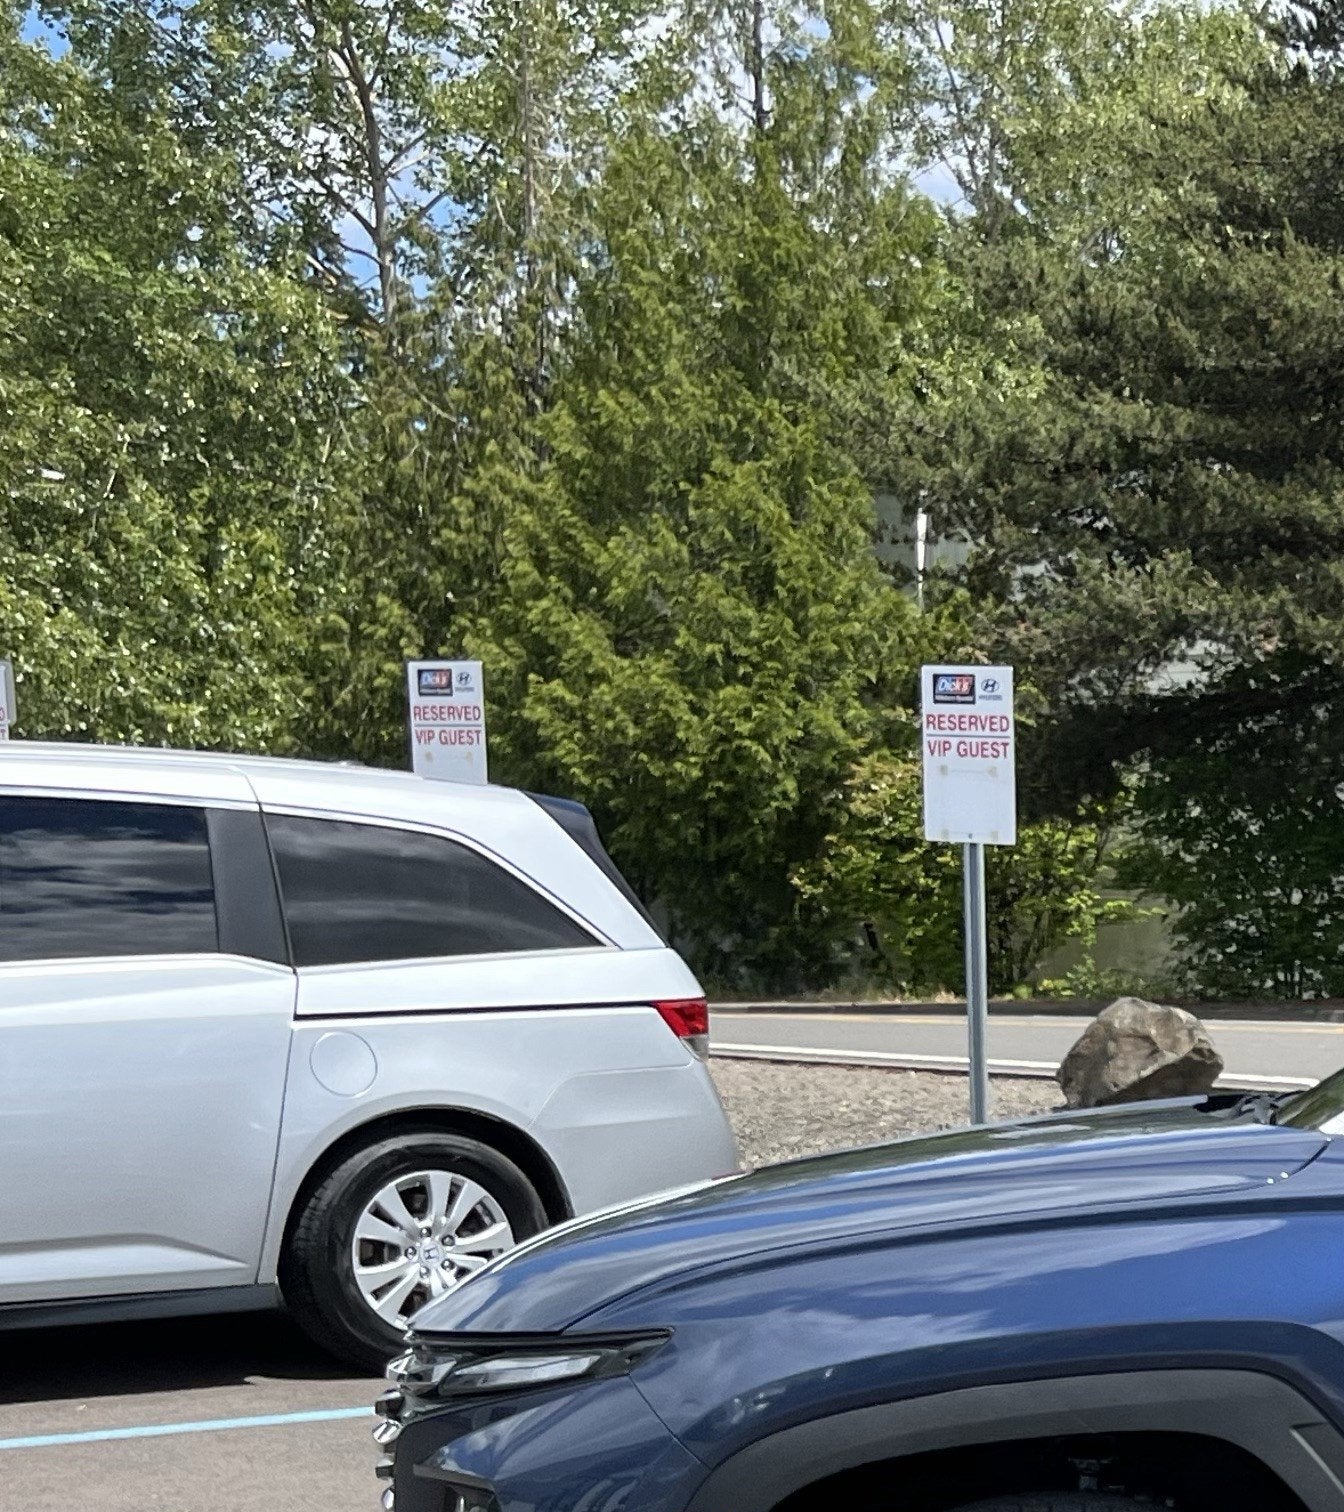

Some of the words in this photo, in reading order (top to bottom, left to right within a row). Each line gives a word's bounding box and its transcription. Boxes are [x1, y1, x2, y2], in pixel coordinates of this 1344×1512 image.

[413, 705, 481, 721] RESERVED
[926, 713, 1010, 732] RESERVED
[415, 729, 435, 745] VIP
[438, 729, 481, 745] GUEST
[927, 740, 952, 757] VIP
[956, 740, 1010, 759] GUEST
